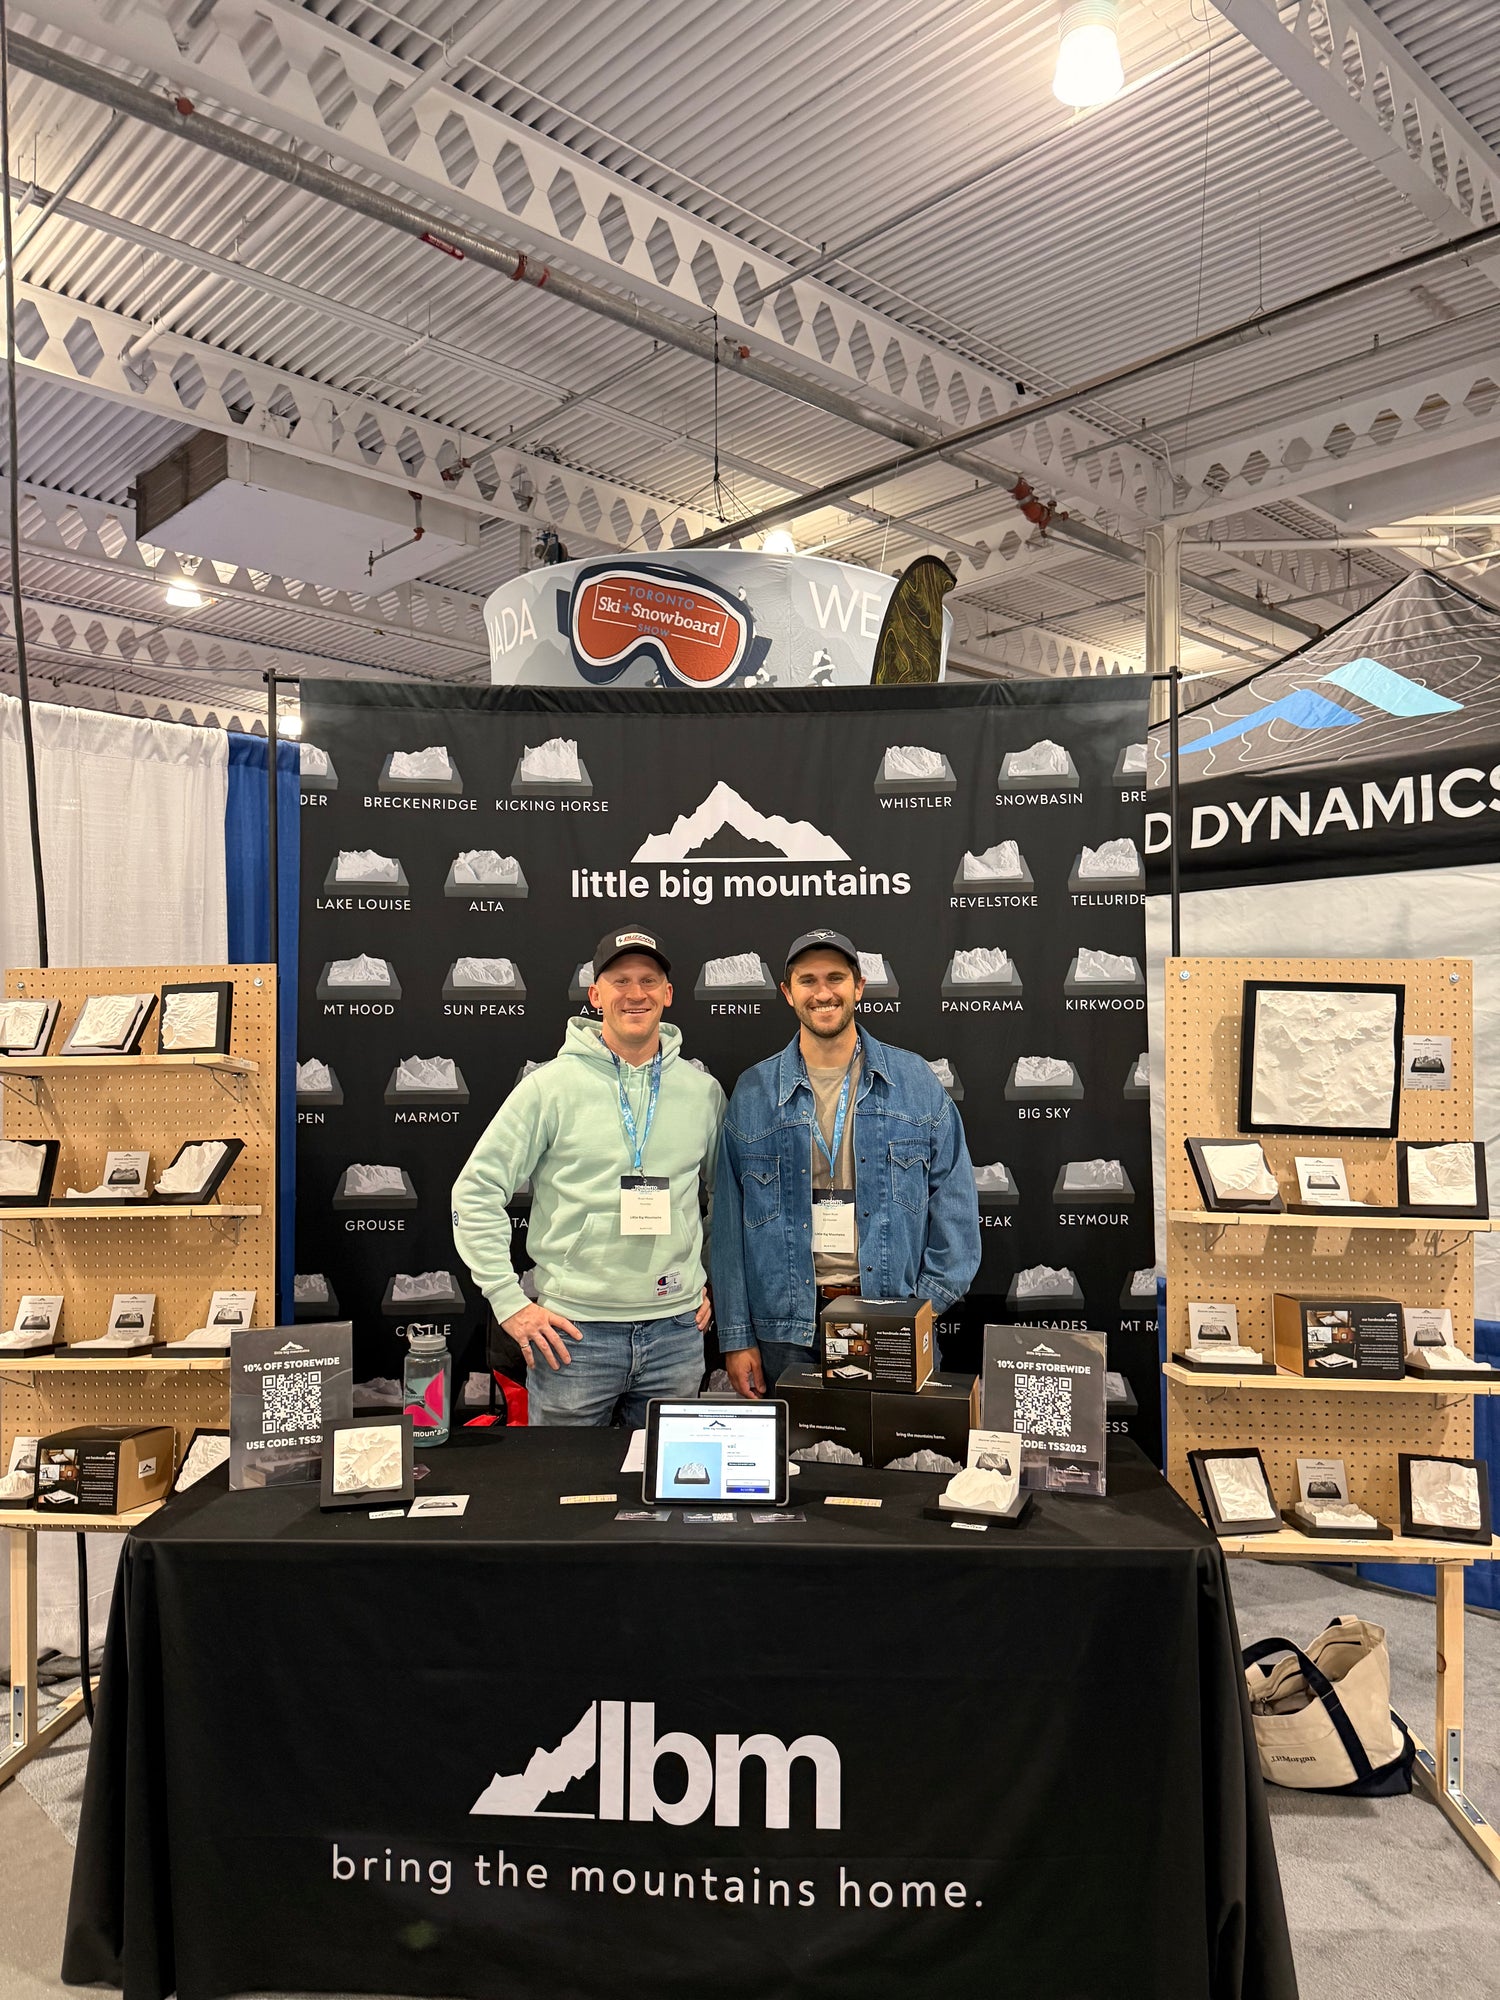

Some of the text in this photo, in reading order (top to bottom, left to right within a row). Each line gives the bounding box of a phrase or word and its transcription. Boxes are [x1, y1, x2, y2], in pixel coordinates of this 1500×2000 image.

[628, 586, 695, 611] TORONTO
[808, 580, 882, 640] WE
[636, 623, 670, 637] SHOW
[300, 794, 328, 806] DER
[879, 796, 952, 809] WHISTLER
[995, 792, 1083, 805] SNOWBASIN
[1121, 790, 1146, 803] BRE
[363, 796, 477, 811] BRECKENRIDGE
[495, 799, 609, 812] KICKING HORSE
[571, 866, 911, 905] little big mountains
[316, 898, 411, 911] LAKE LOUISE
[469, 900, 504, 912] ALTA
[950, 896, 1038, 908] REVELSTOKE
[1071, 893, 1146, 906] TELLURIDE
[323, 1004, 394, 1016] MT HOOD
[443, 1004, 525, 1016] SUN PEAKS
[710, 1003, 761, 1015] FERNIE
[855, 1001, 901, 1013] MBOAT
[941, 1001, 1024, 1012] PANORAMA
[1065, 999, 1145, 1011] KIRKWOOD
[296, 1112, 325, 1124] PEN
[394, 1111, 460, 1123] MARMOT
[1018, 1107, 1071, 1119] BIG SKY
[344, 1219, 405, 1232] GROUSE
[978, 1215, 1012, 1227] PEAK
[1059, 1213, 1129, 1226] SEYMOUR
[935, 1322, 961, 1334] SIF
[1120, 1320, 1141, 1332] MT
[243, 1356, 340, 1373] 10% OFF STOREWIDE
[996, 1360, 1091, 1375] 10% OFF STOREWIDE
[246, 1434, 324, 1450] USE CODE: TSS2
[1048, 1441, 1088, 1454] TSS2025
[600, 1700, 841, 1830] lbm
[332, 1843, 984, 1908] bring the mountains home.
